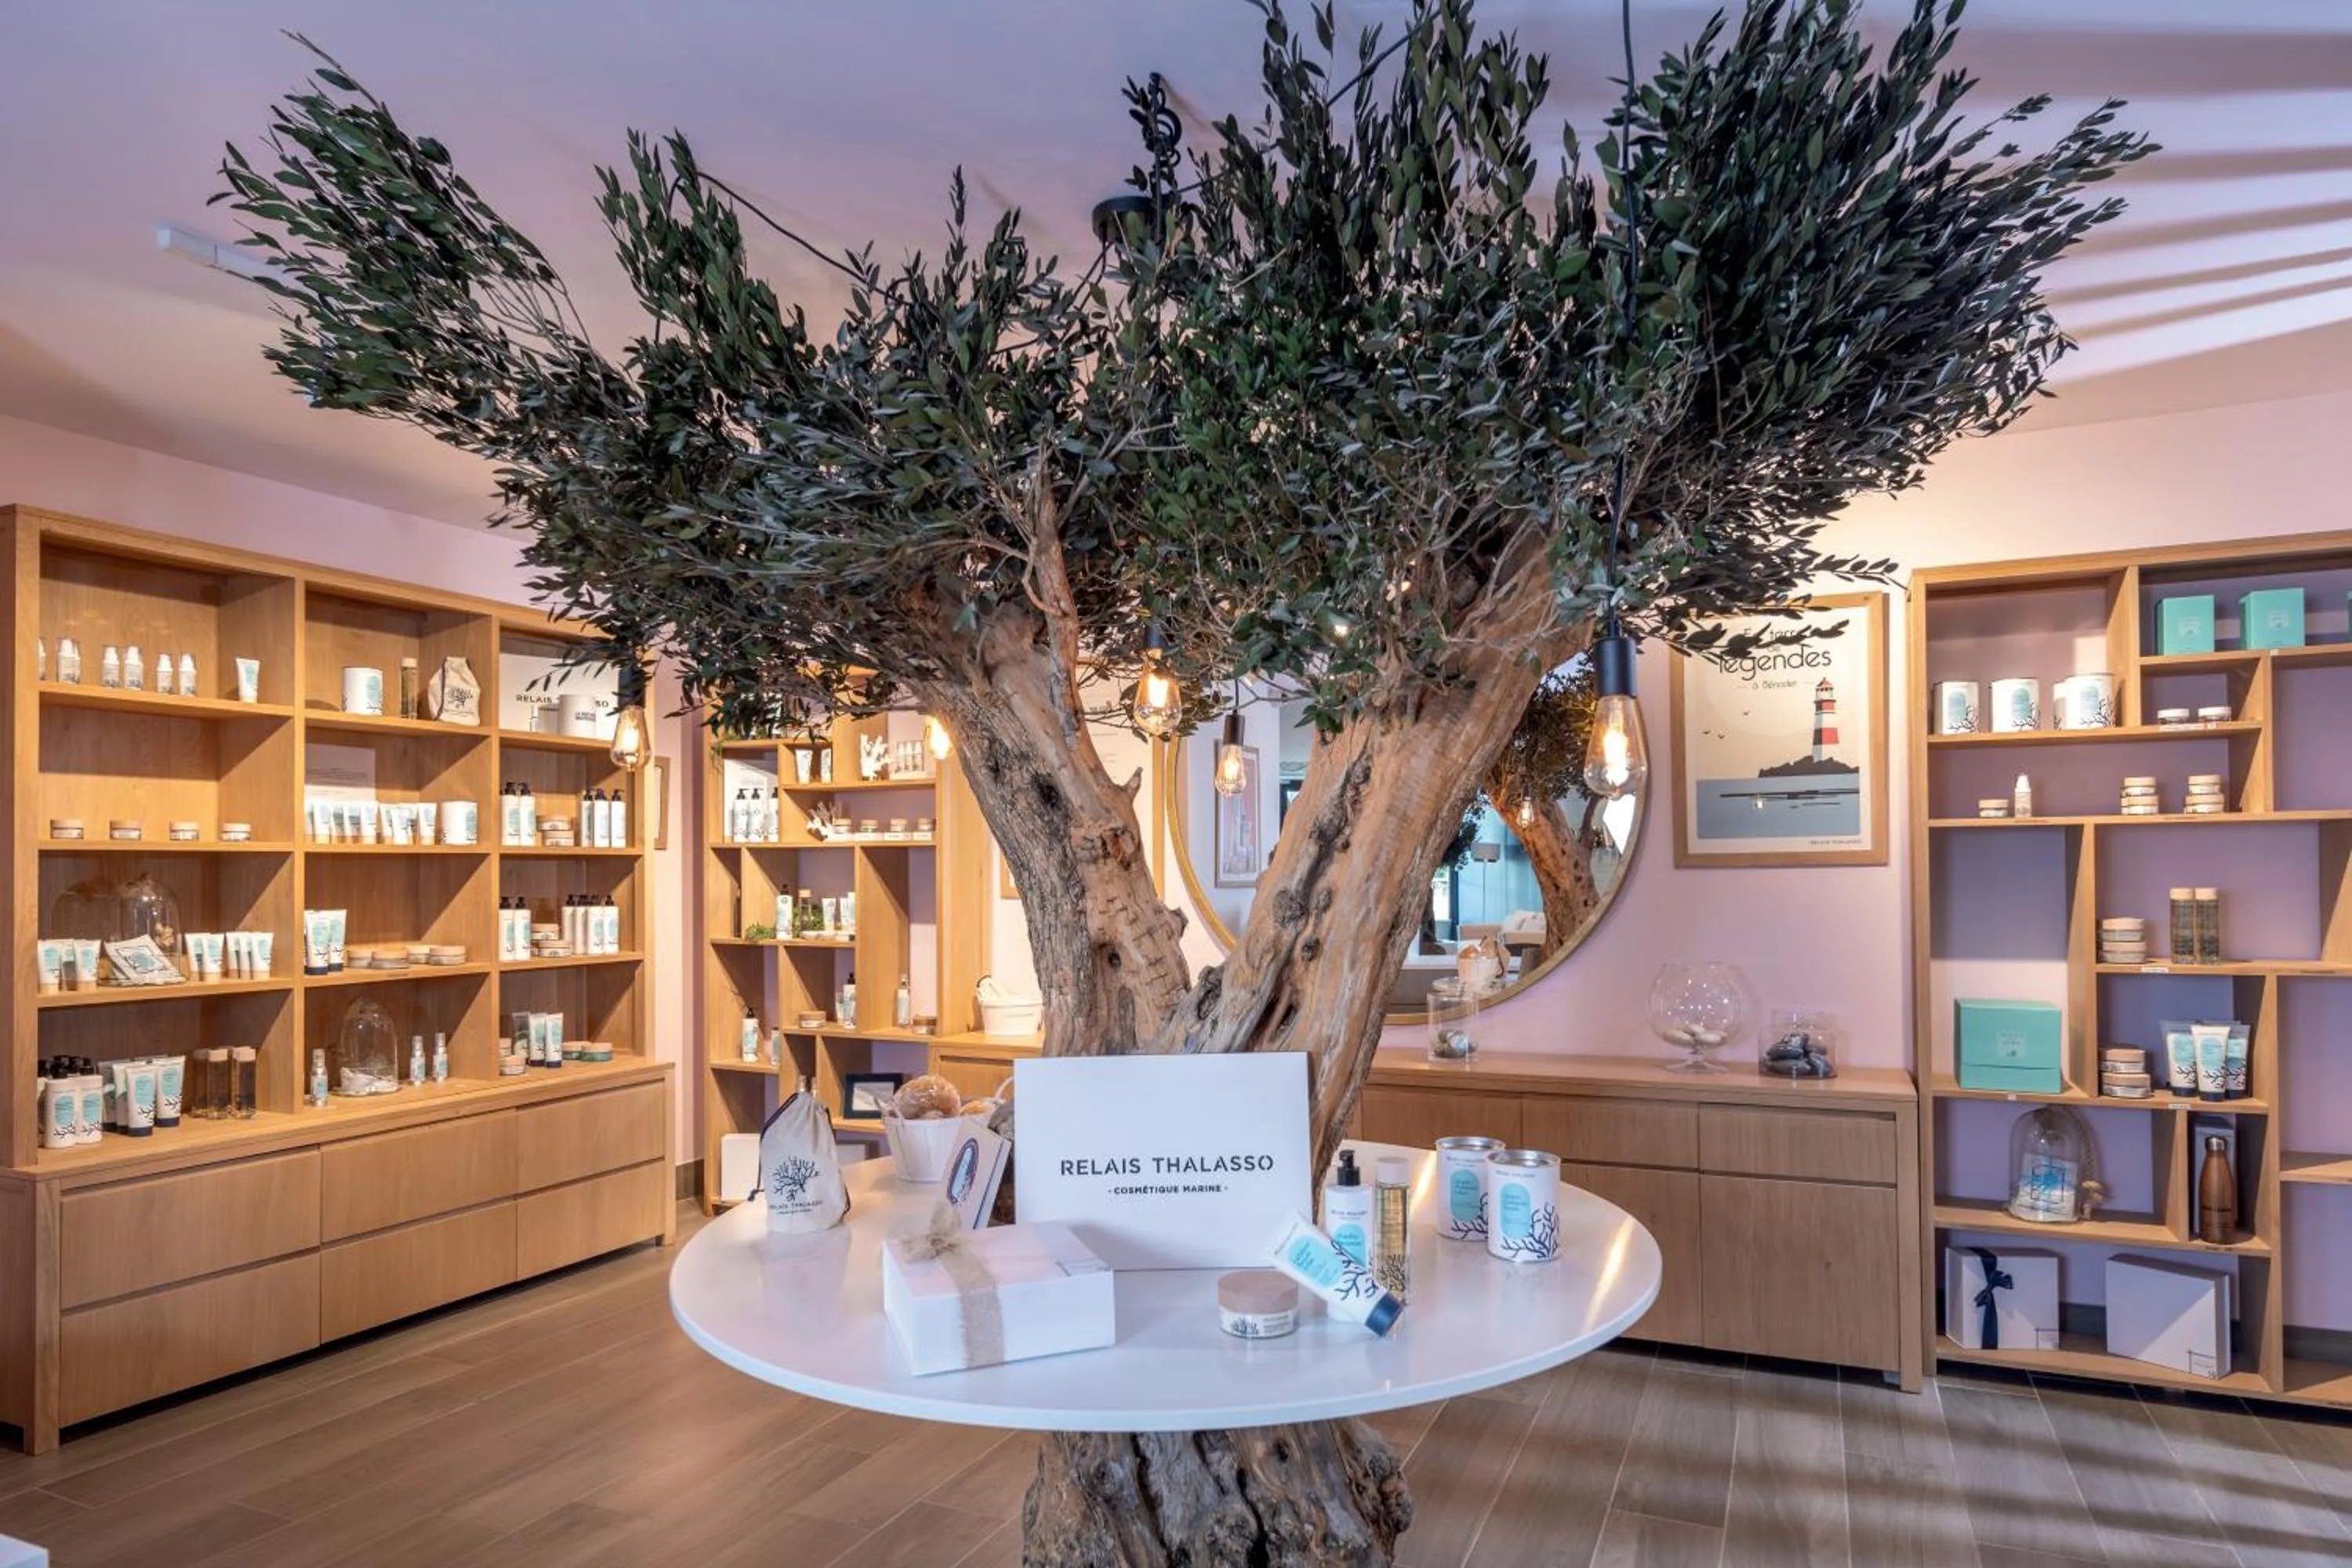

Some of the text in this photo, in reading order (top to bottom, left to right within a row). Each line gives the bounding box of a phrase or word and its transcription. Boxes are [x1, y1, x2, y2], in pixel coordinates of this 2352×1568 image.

[516, 694, 553, 704] RELAIS
[1061, 1155, 1274, 1175] RELAIS THALASSO
[1114, 1184, 1221, 1194] COSMÉTIQUE MARINE
